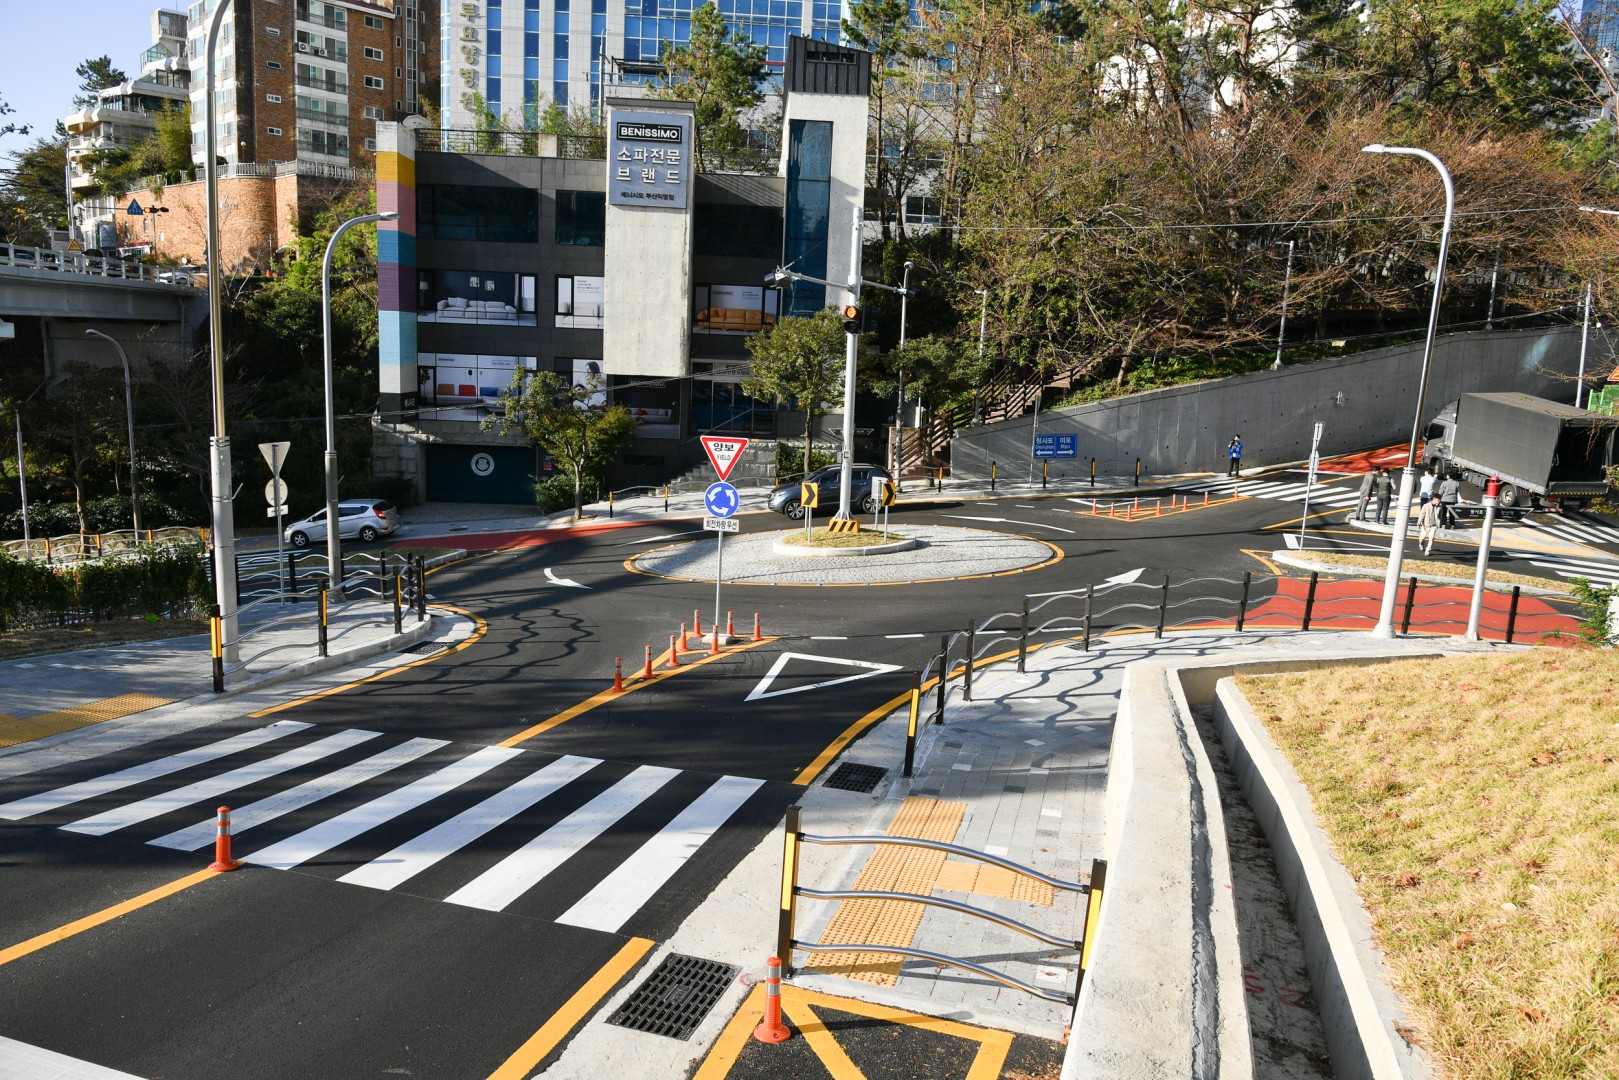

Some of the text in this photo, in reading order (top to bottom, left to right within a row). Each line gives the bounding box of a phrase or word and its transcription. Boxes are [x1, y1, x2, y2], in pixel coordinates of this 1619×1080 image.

[617, 146, 681, 165] 소파전문
[1059, 436, 1072, 444] 미포
[713, 442, 735, 452] 양보
